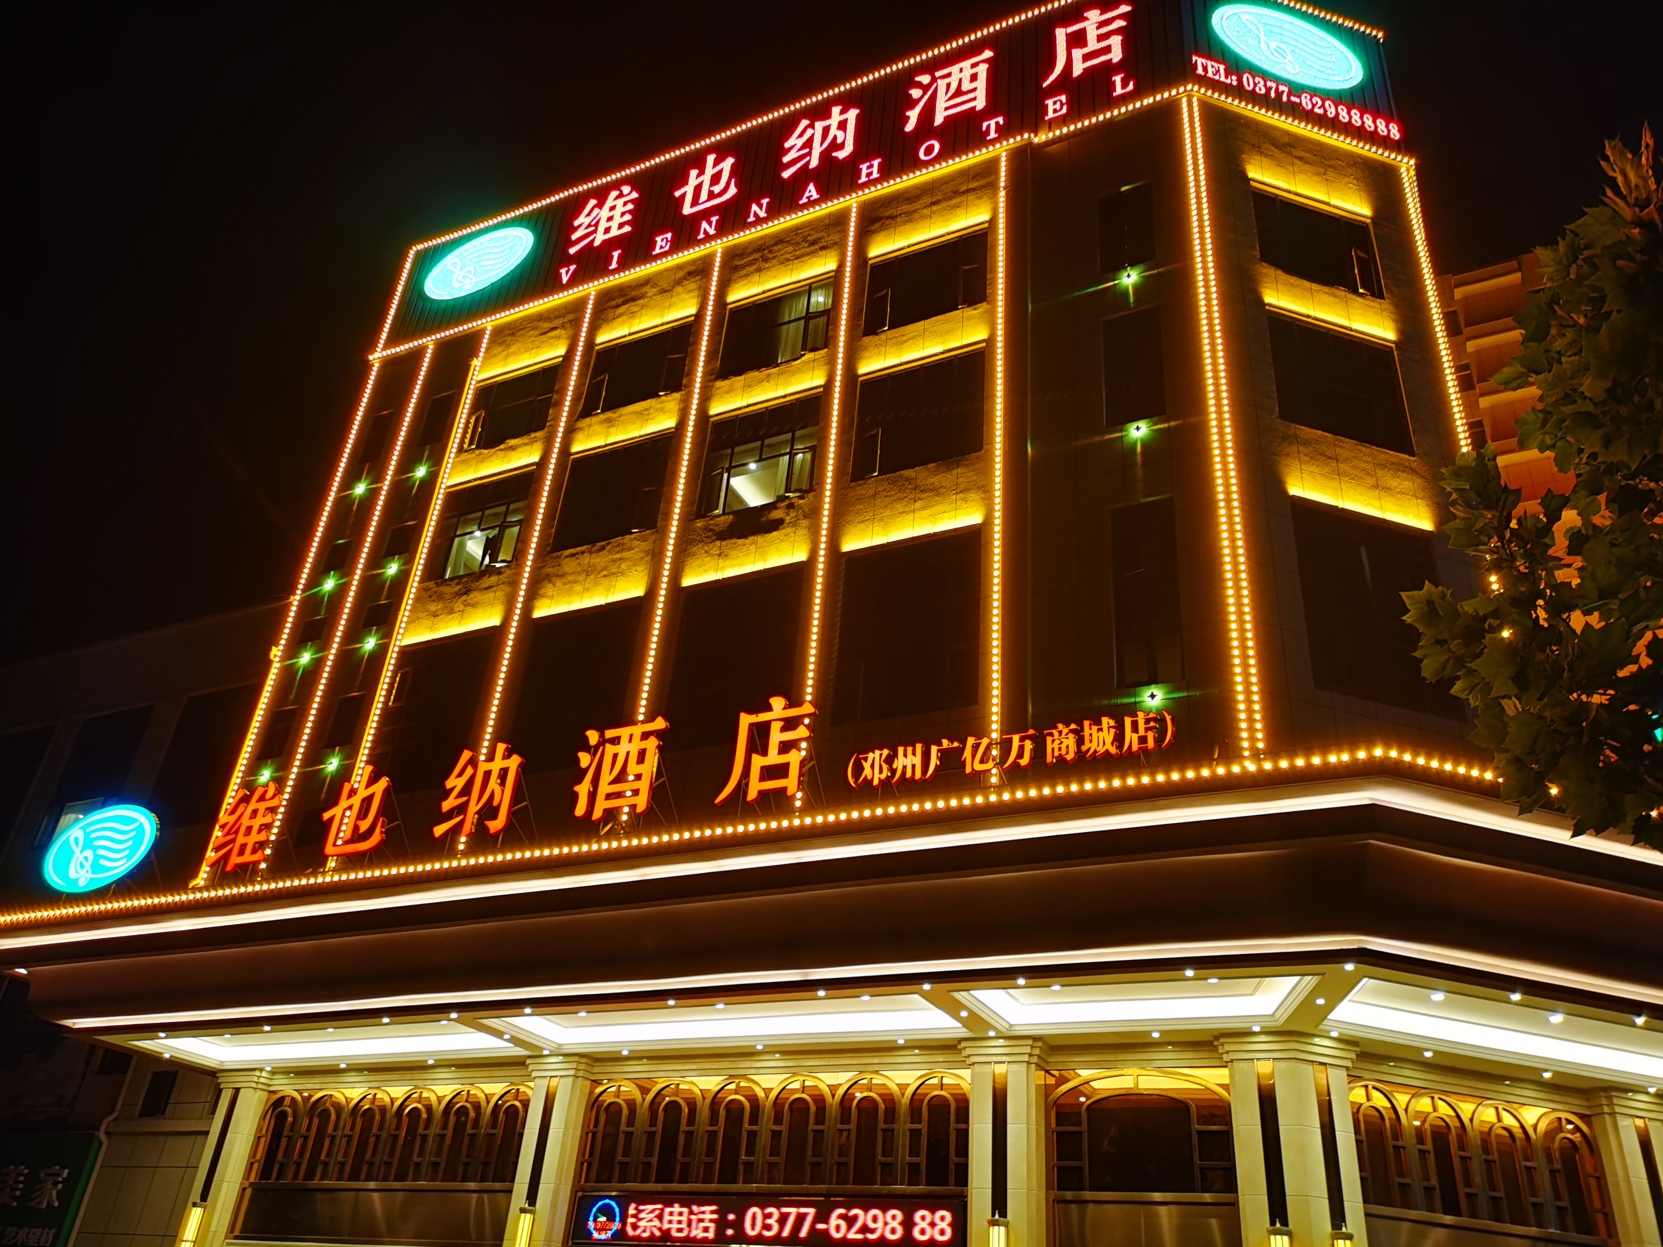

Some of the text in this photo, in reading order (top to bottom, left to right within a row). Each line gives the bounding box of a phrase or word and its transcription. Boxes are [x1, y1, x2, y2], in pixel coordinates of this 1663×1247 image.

[568, 4, 1133, 256] 维也纳酒店
[1192, 54, 1401, 141] TEL: 0377-62988888
[205, 695, 817, 873] 维也纳酒店
[846, 708, 1175, 789] （邓州广亿万商城店）
